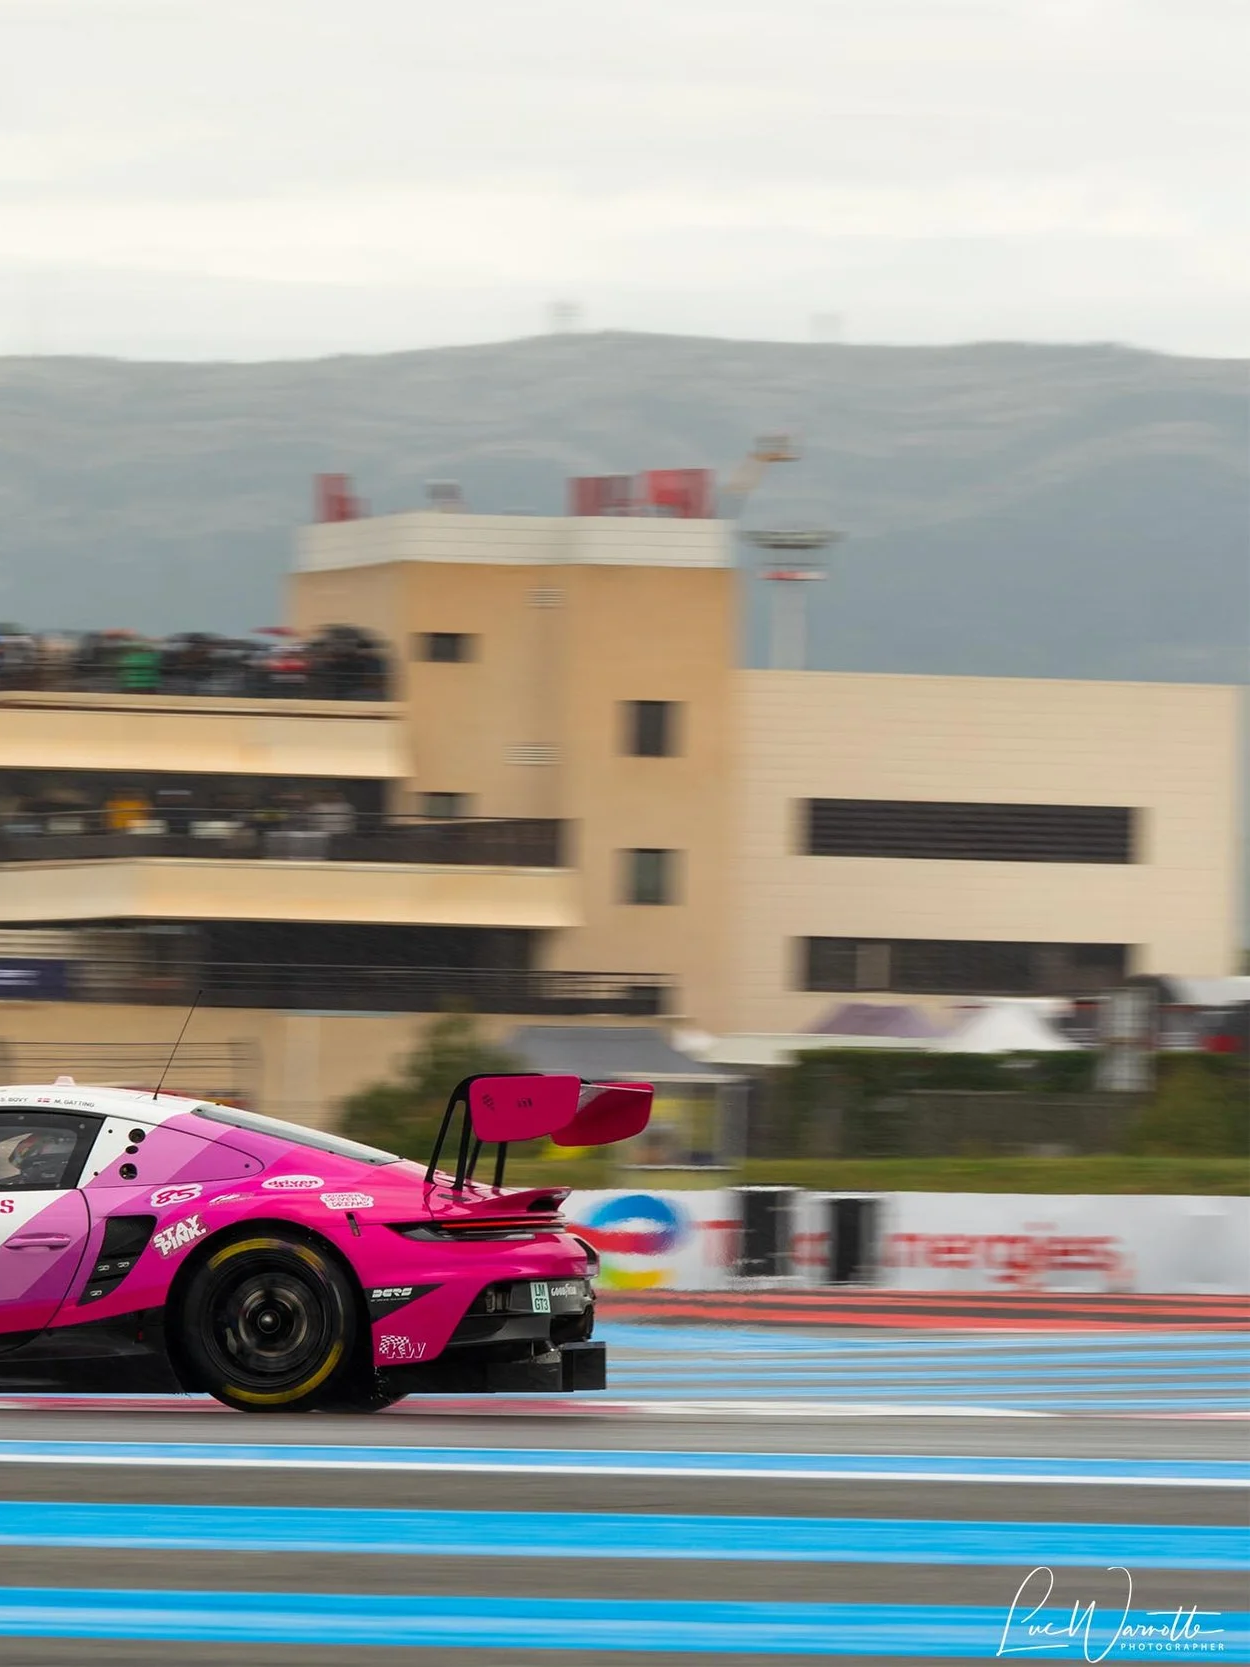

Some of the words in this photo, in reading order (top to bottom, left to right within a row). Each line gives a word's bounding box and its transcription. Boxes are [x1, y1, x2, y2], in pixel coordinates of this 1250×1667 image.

[155, 1187, 198, 1205] 85
[154, 1214, 199, 1248] STAY
[534, 1284, 546, 1296] LM
[534, 1298, 549, 1310] GT3
